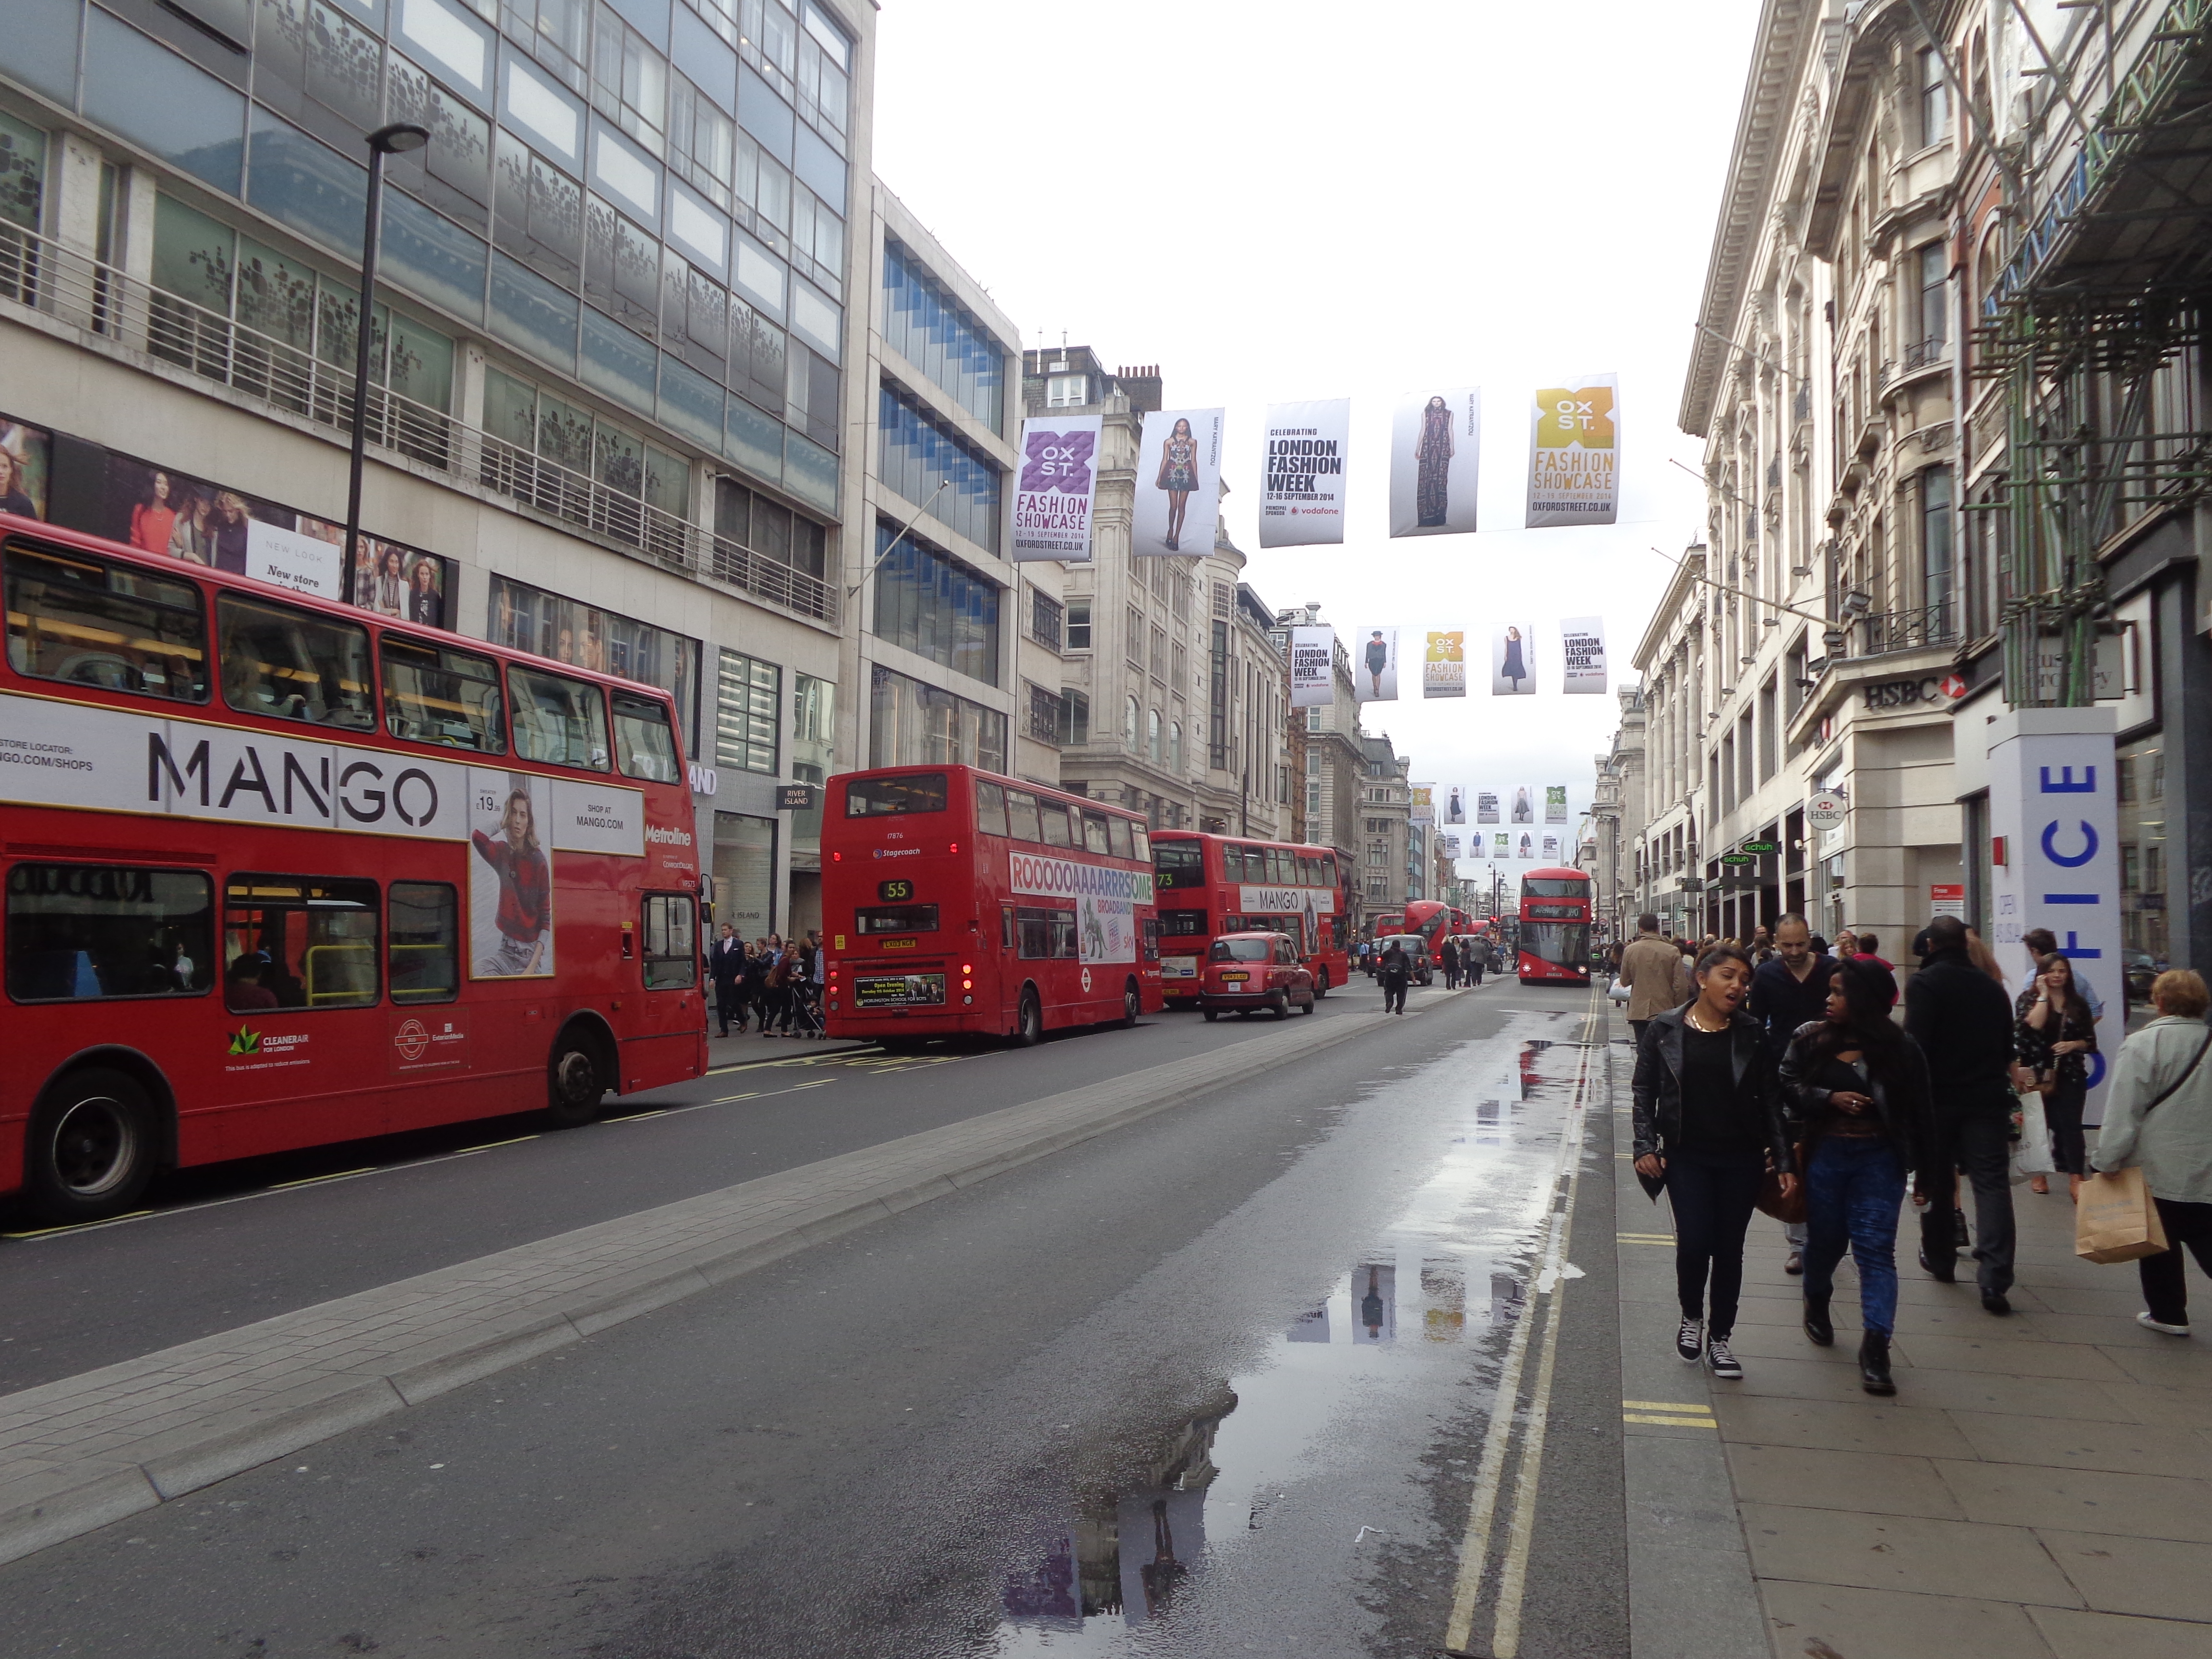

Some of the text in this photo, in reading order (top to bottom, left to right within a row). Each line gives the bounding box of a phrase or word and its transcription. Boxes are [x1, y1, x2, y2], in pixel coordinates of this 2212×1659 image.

[1556, 400, 1593, 414] OX
[1558, 415, 1595, 430] ST.
[1042, 446, 1075, 460] OX
[1269, 440, 1337, 456] LONDON
[1268, 456, 1341, 474] FASHION
[1535, 451, 1614, 471] FASHION
[1041, 462, 1073, 477] ST.
[1267, 474, 1316, 492] WEEK
[1534, 472, 1612, 490] SHOWCASE
[1284, 493, 1318, 501] SEPTEMBER
[1017, 494, 1087, 515] FASHION
[1533, 502, 1611, 512] OXFORDSTREET.CO.UK
[1016, 513, 1085, 530] SHOWCASE
[266, 541, 323, 563] NEW LOOK
[1016, 540, 1083, 551] OXFORDSTREET.CO.UK
[267, 565, 319, 587] New store
[1565, 638, 1599, 647] LONDON
[1295, 649, 1327, 658] LONDON
[1565, 647, 1603, 656] FASHION
[1295, 658, 1329, 667] FASHION
[1566, 656, 1591, 665] WEEK
[1295, 667, 1317, 676] WEEK
[1426, 663, 1463, 673] FASHION
[1426, 673, 1463, 681] SHOWCASE
[1863, 676, 1937, 708] HSBC
[0, 739, 73, 754] STORE LOCATOR:
[0, 753, 93, 771] GO.COM/SHOPS
[149, 733, 437, 827] MANGO
[588, 805, 603, 813] SHOP
[1810, 811, 1841, 819] HSBC
[577, 816, 623, 830] MANGO.COM
[645, 824, 691, 846] Metroline
[883, 848, 920, 857] Stagecoach
[1158, 874, 1172, 886] 73
[888, 883, 906, 897] 55
[1260, 890, 1298, 909] MANGO
[1124, 932, 1134, 952] sky
